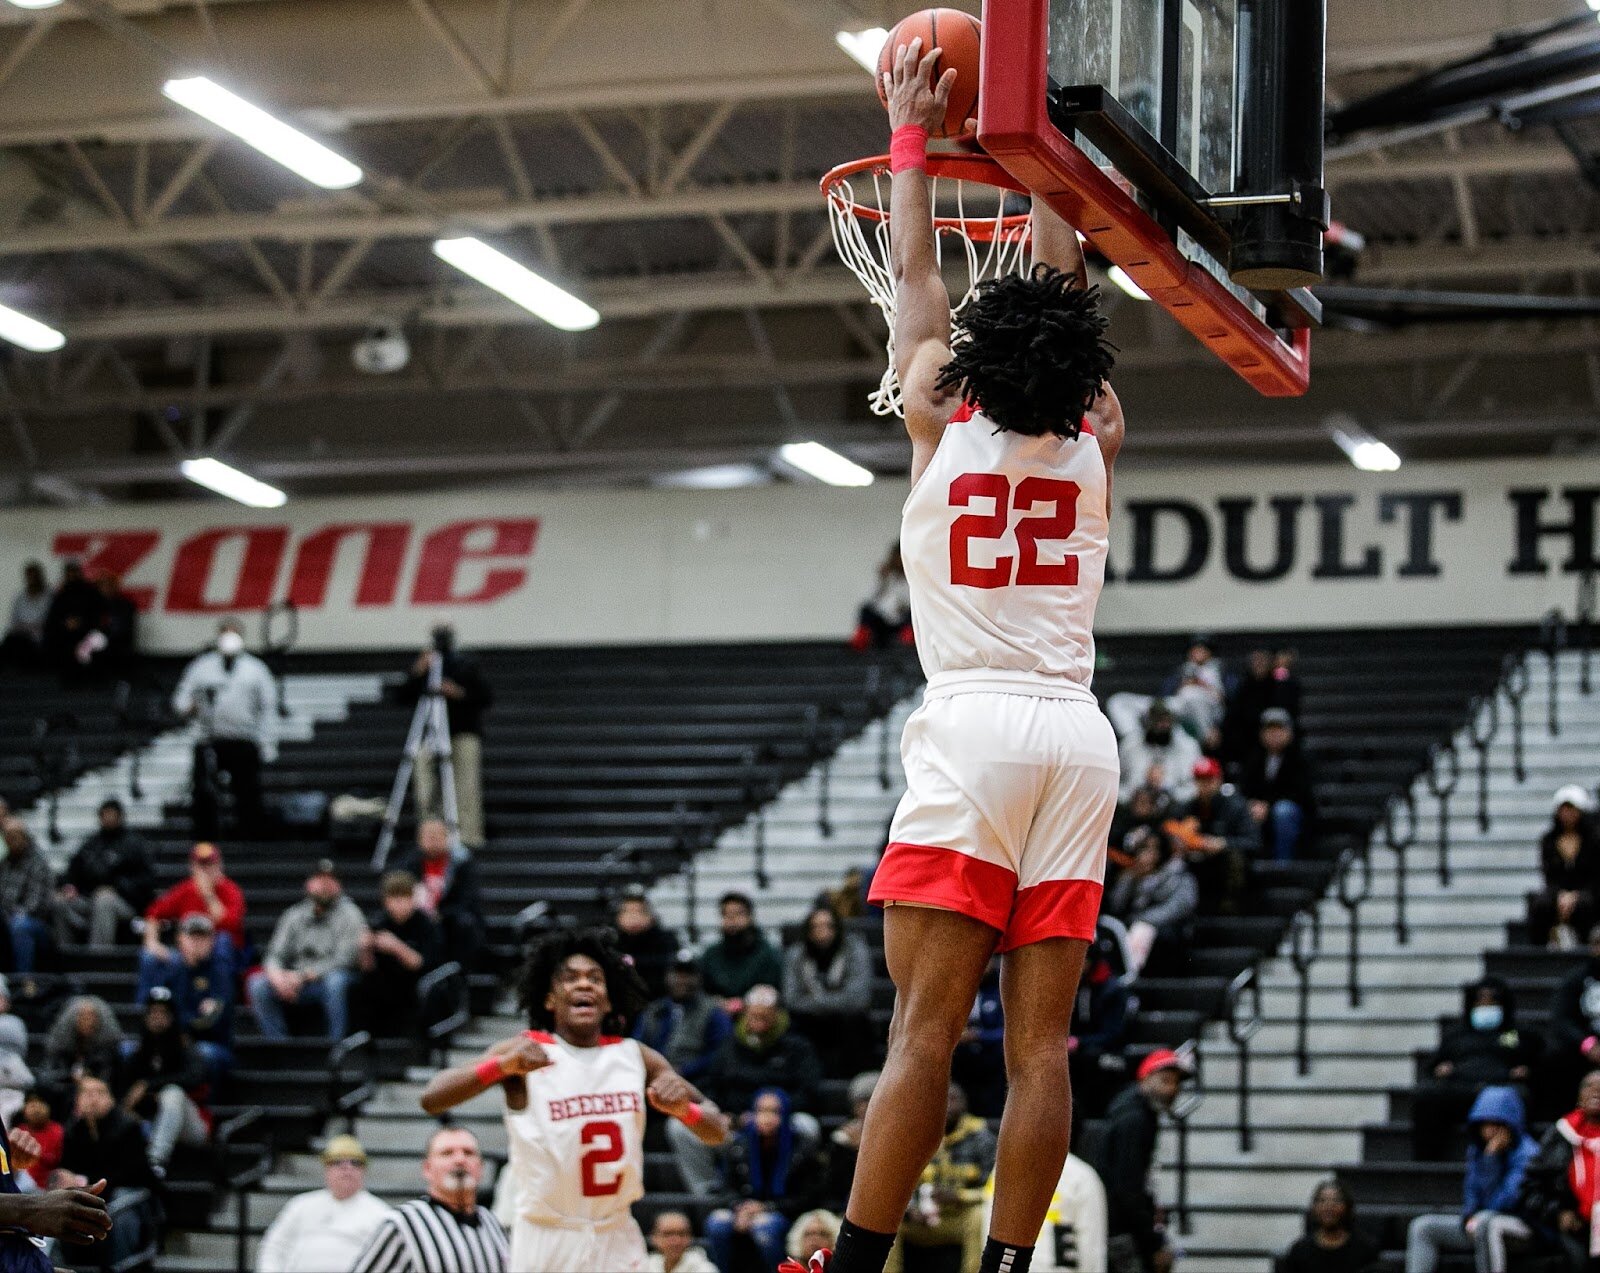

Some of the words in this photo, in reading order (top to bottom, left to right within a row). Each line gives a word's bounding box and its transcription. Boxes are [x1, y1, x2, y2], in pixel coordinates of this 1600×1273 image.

[948, 472, 1082, 589] 22
[1104, 489, 1464, 586] DULT
[581, 1120, 624, 1197] 2
